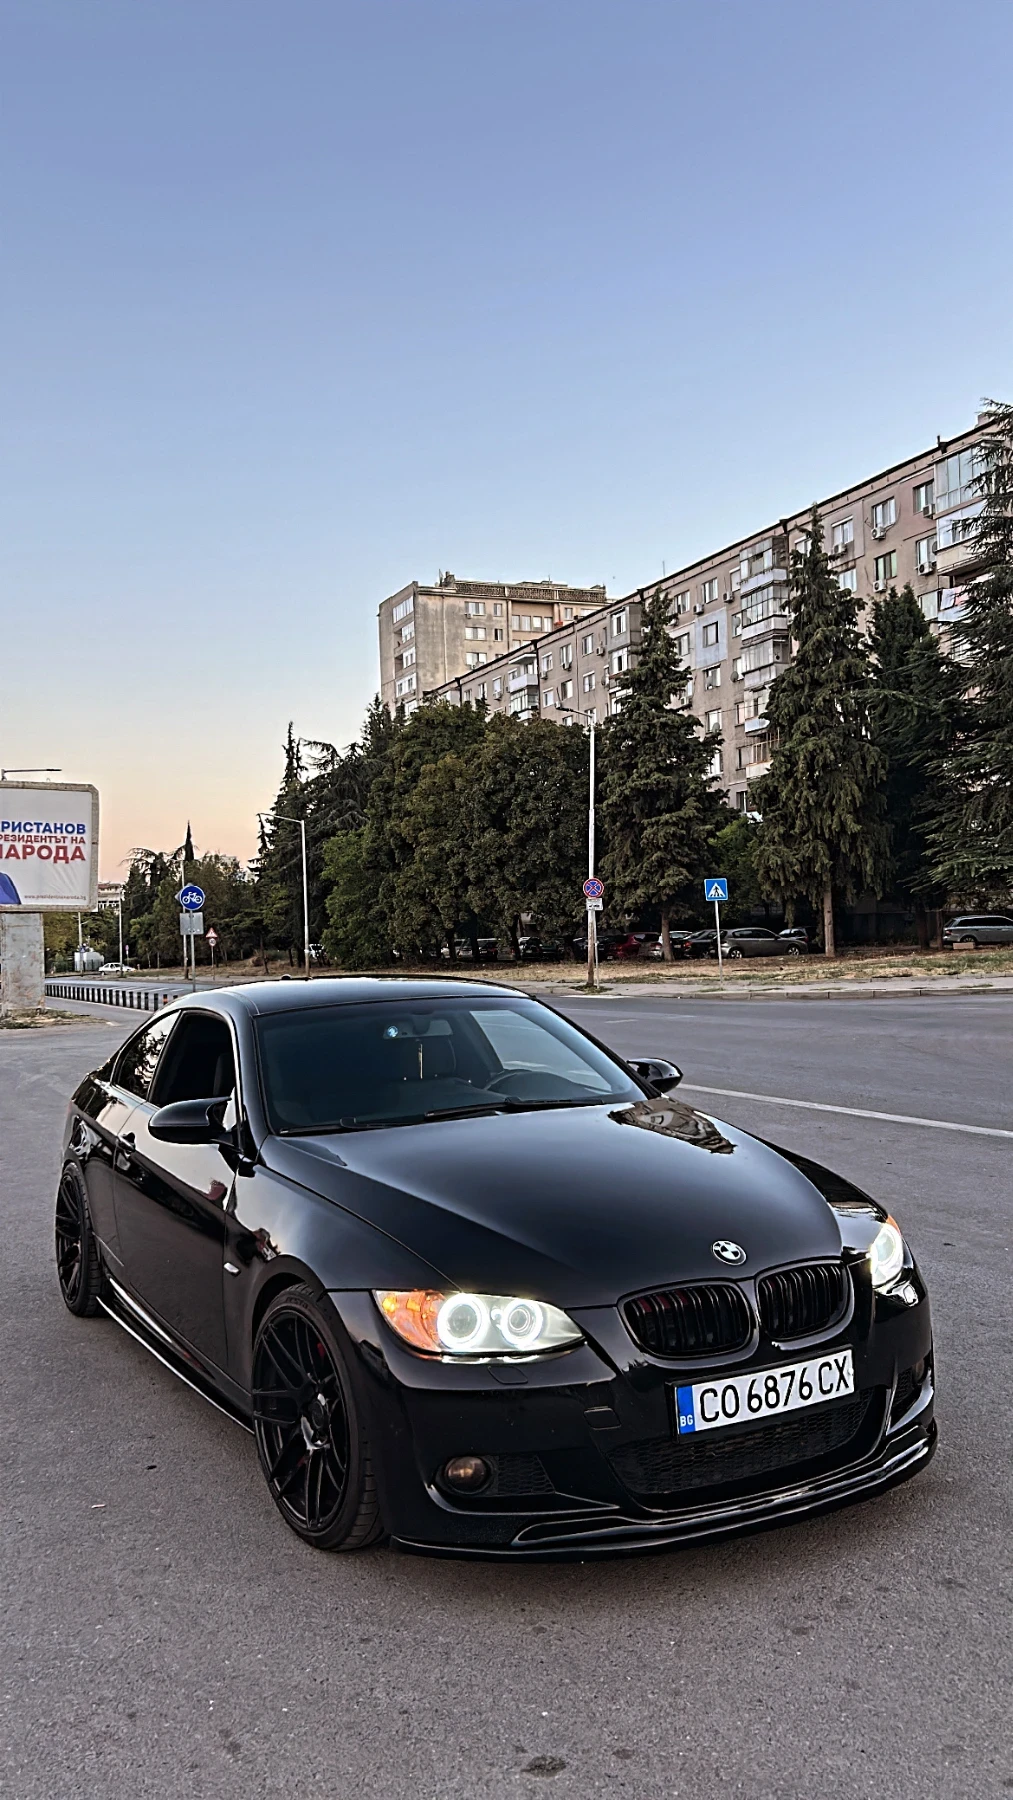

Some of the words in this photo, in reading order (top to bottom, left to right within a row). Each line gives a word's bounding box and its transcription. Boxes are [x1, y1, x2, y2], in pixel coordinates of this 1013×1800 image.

[1, 821, 86, 834] РИСТАНОВ
[70, 836, 86, 844] НА
[0, 844, 86, 864] АРОДА
[699, 1384, 740, 1423] CO
[747, 1367, 813, 1413] 6876
[818, 1356, 850, 1395] CX
[680, 1415, 694, 1427] BG
